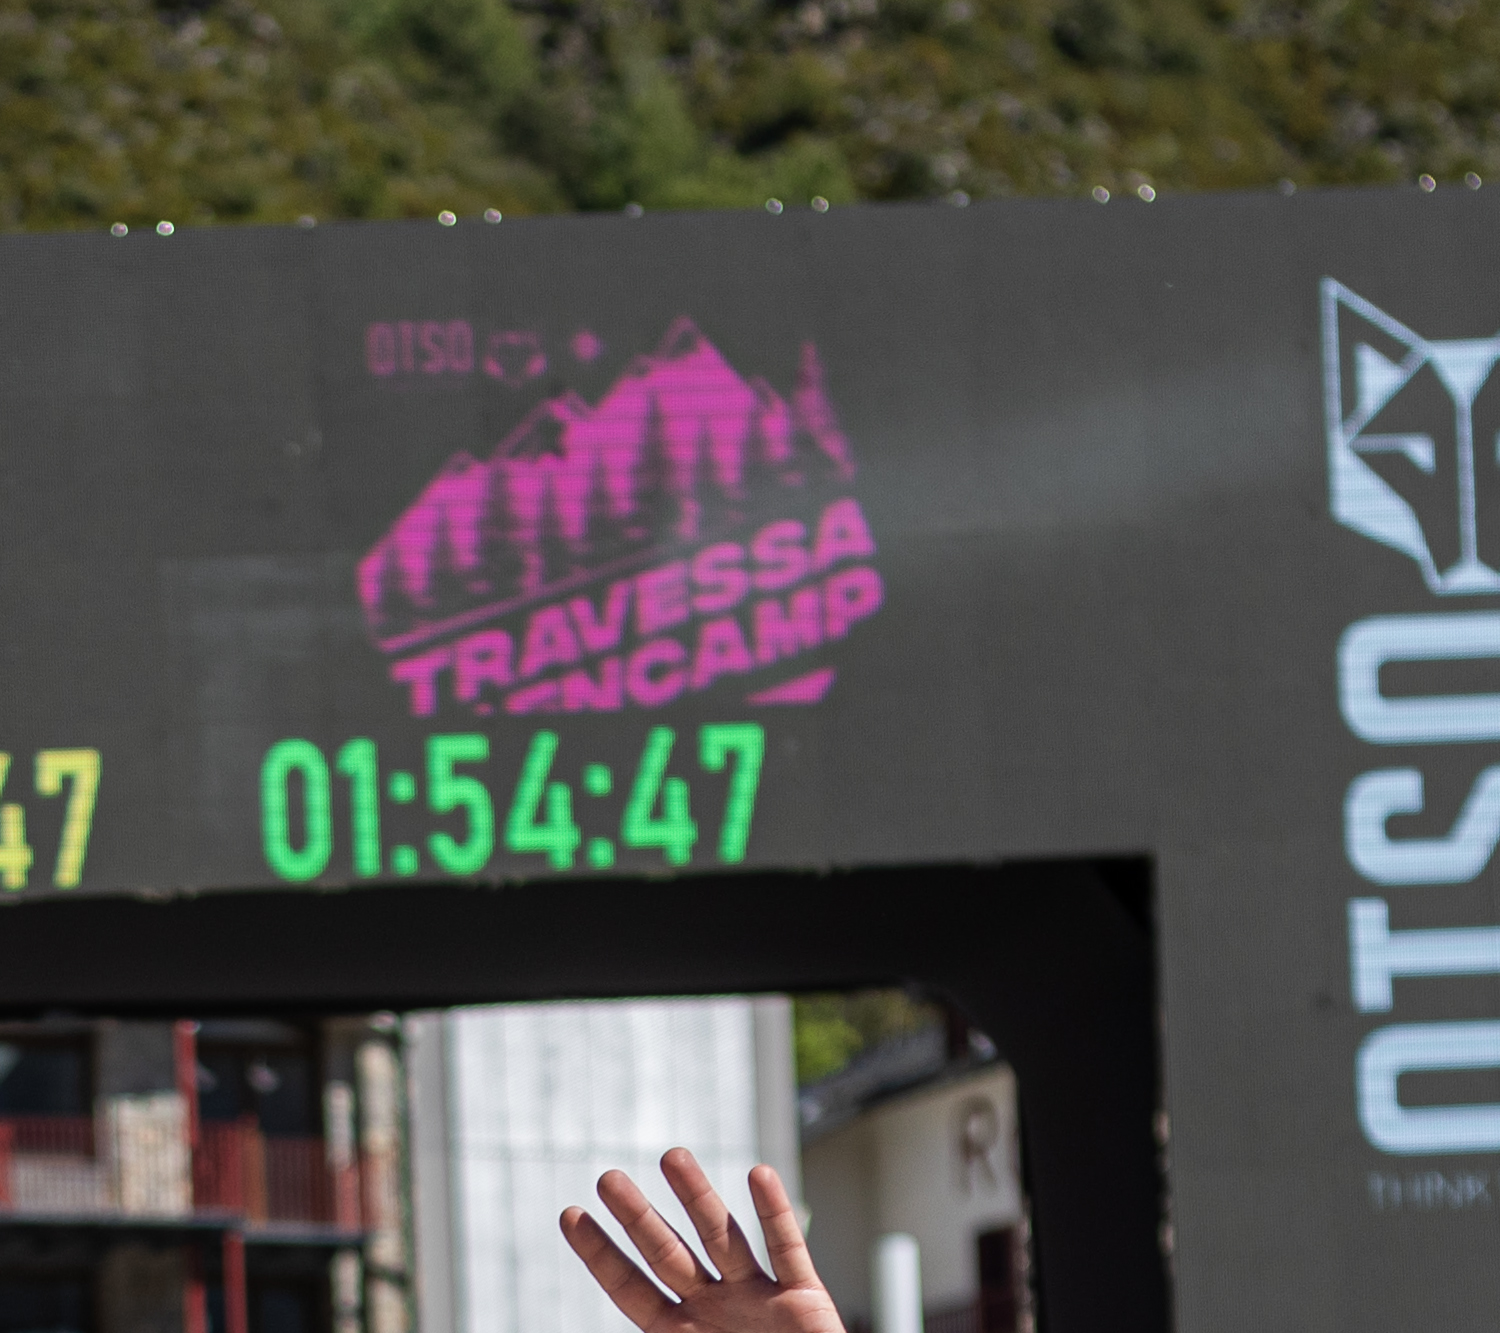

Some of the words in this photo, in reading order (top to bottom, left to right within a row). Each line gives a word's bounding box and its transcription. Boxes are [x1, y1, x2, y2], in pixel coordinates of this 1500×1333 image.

[391, 498, 876, 717] TRAVESSA
[261, 723, 765, 882] 01:54:47
[1369, 1169, 1491, 1209] THINK
